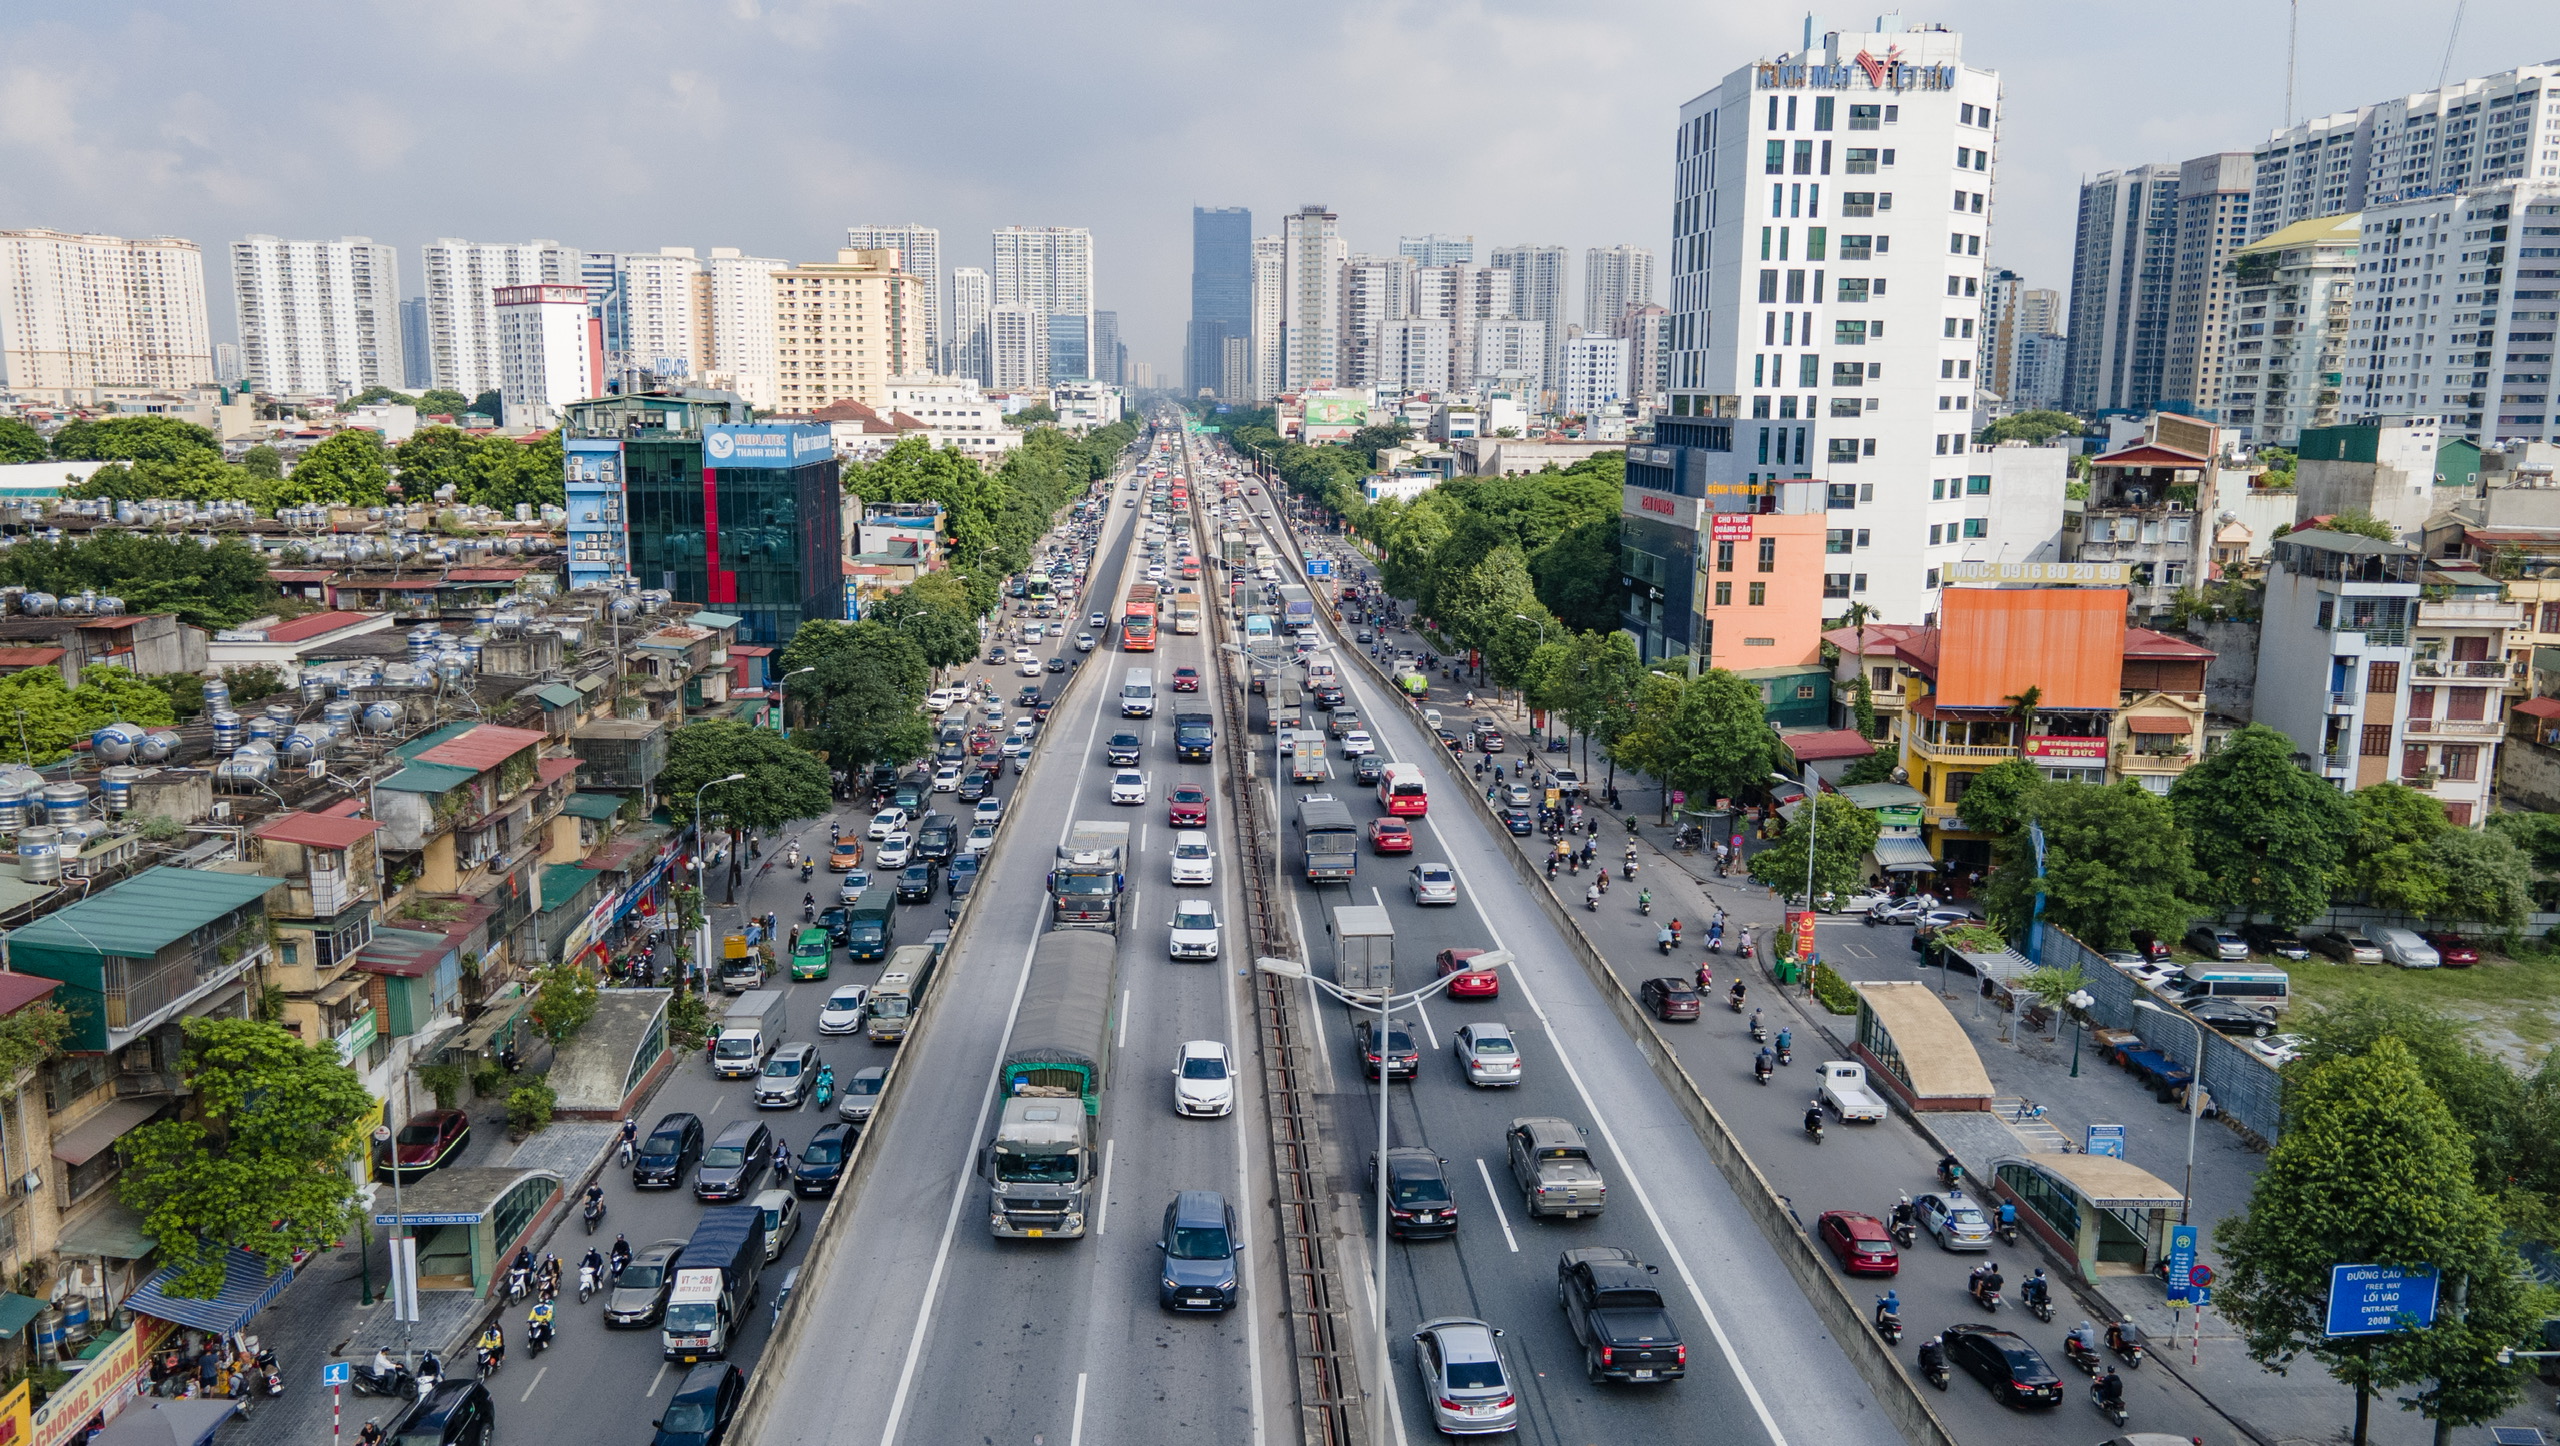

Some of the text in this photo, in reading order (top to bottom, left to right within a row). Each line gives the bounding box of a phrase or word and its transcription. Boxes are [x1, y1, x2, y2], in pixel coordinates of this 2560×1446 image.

[735, 434, 787, 445] MEDLATEC
[736, 446, 787, 457] THANH XUÂN
[1707, 481, 1728, 497] BỆNH
[1731, 481, 1748, 497] VIỆN
[1653, 497, 1675, 516] TOWER
[1732, 515, 1748, 523] THUÊ
[1714, 524, 1751, 534] QUẢNG CÁO
[1951, 563, 2121, 580] MQC: 0916 80 20 99
[2049, 748, 2096, 756] TRÍ ĐỨC
[681, 1276, 713, 1284] VT 286
[2347, 1269, 2379, 1281] ĐƯỜNG
[2382, 1270, 2401, 1279] CAO
[2363, 1290, 2399, 1302] LỐI VÀO
[2361, 1305, 2399, 1313] ENTRANCE
[2367, 1317, 2390, 1326] 200M
[34, 1389, 90, 1446] CHỐNG
[92, 1347, 136, 1399] THẤM
